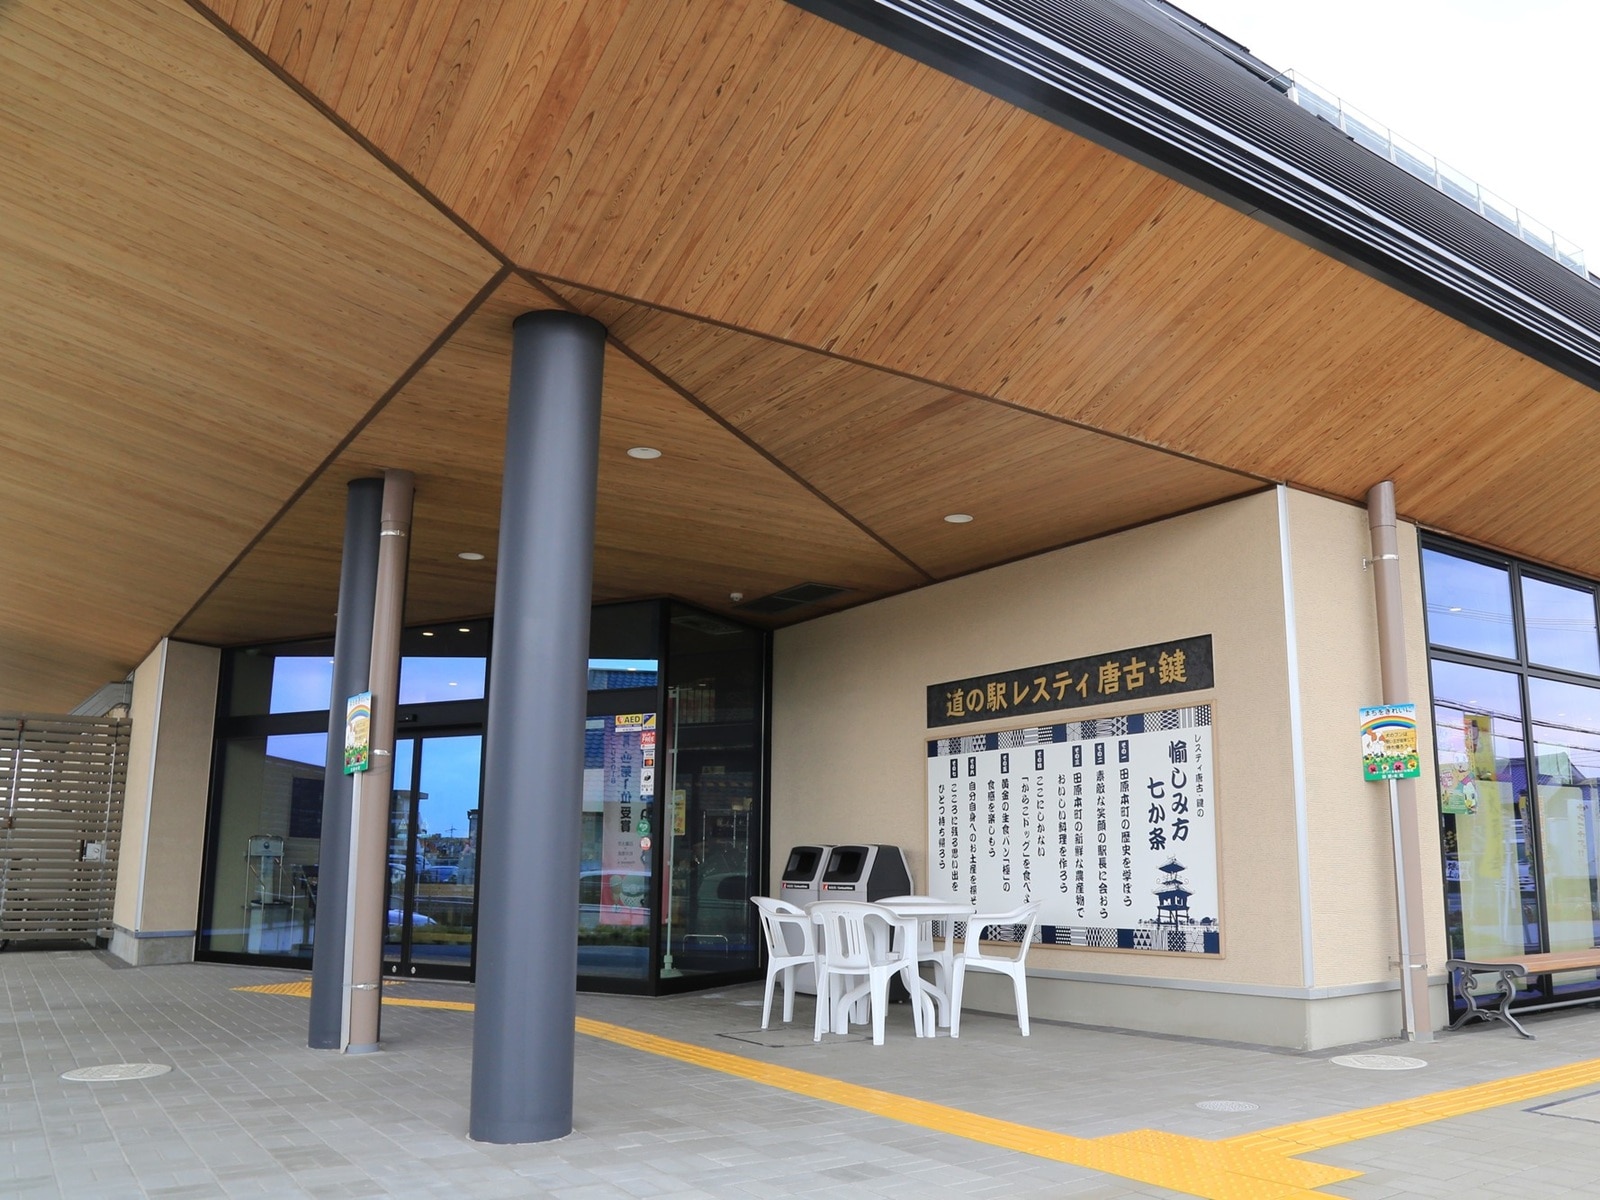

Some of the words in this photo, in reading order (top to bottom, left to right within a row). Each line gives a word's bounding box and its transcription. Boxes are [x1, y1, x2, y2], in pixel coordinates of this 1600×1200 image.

[624, 715, 641, 724] AED
[946, 648, 1188, 718] 道の駅レスティ唐古・鍵
[938, 784, 946, 870] ひとつ持ち帰ろう
[950, 783, 959, 892] こころに残る思い出を
[987, 779, 996, 858] 食感を楽しもう
[1021, 776, 1032, 904] 「からこドッグ」を食べよ
[1036, 775, 1046, 857] ここにしかない
[1057, 774, 1068, 894] おいしい料理を作ろう
[1119, 767, 1133, 907] 田原本町の歴史を学ぼう
[1146, 776, 1167, 851] 七か条
[1168, 739, 1190, 842] 愉しみ方
[968, 780, 978, 914] 自分自身へのお土産を探そ
[1072, 771, 1085, 919] 田原本町の新鮮な農産物で
[1095, 769, 1109, 920] 素敵な笑顔の駅長に会おう
